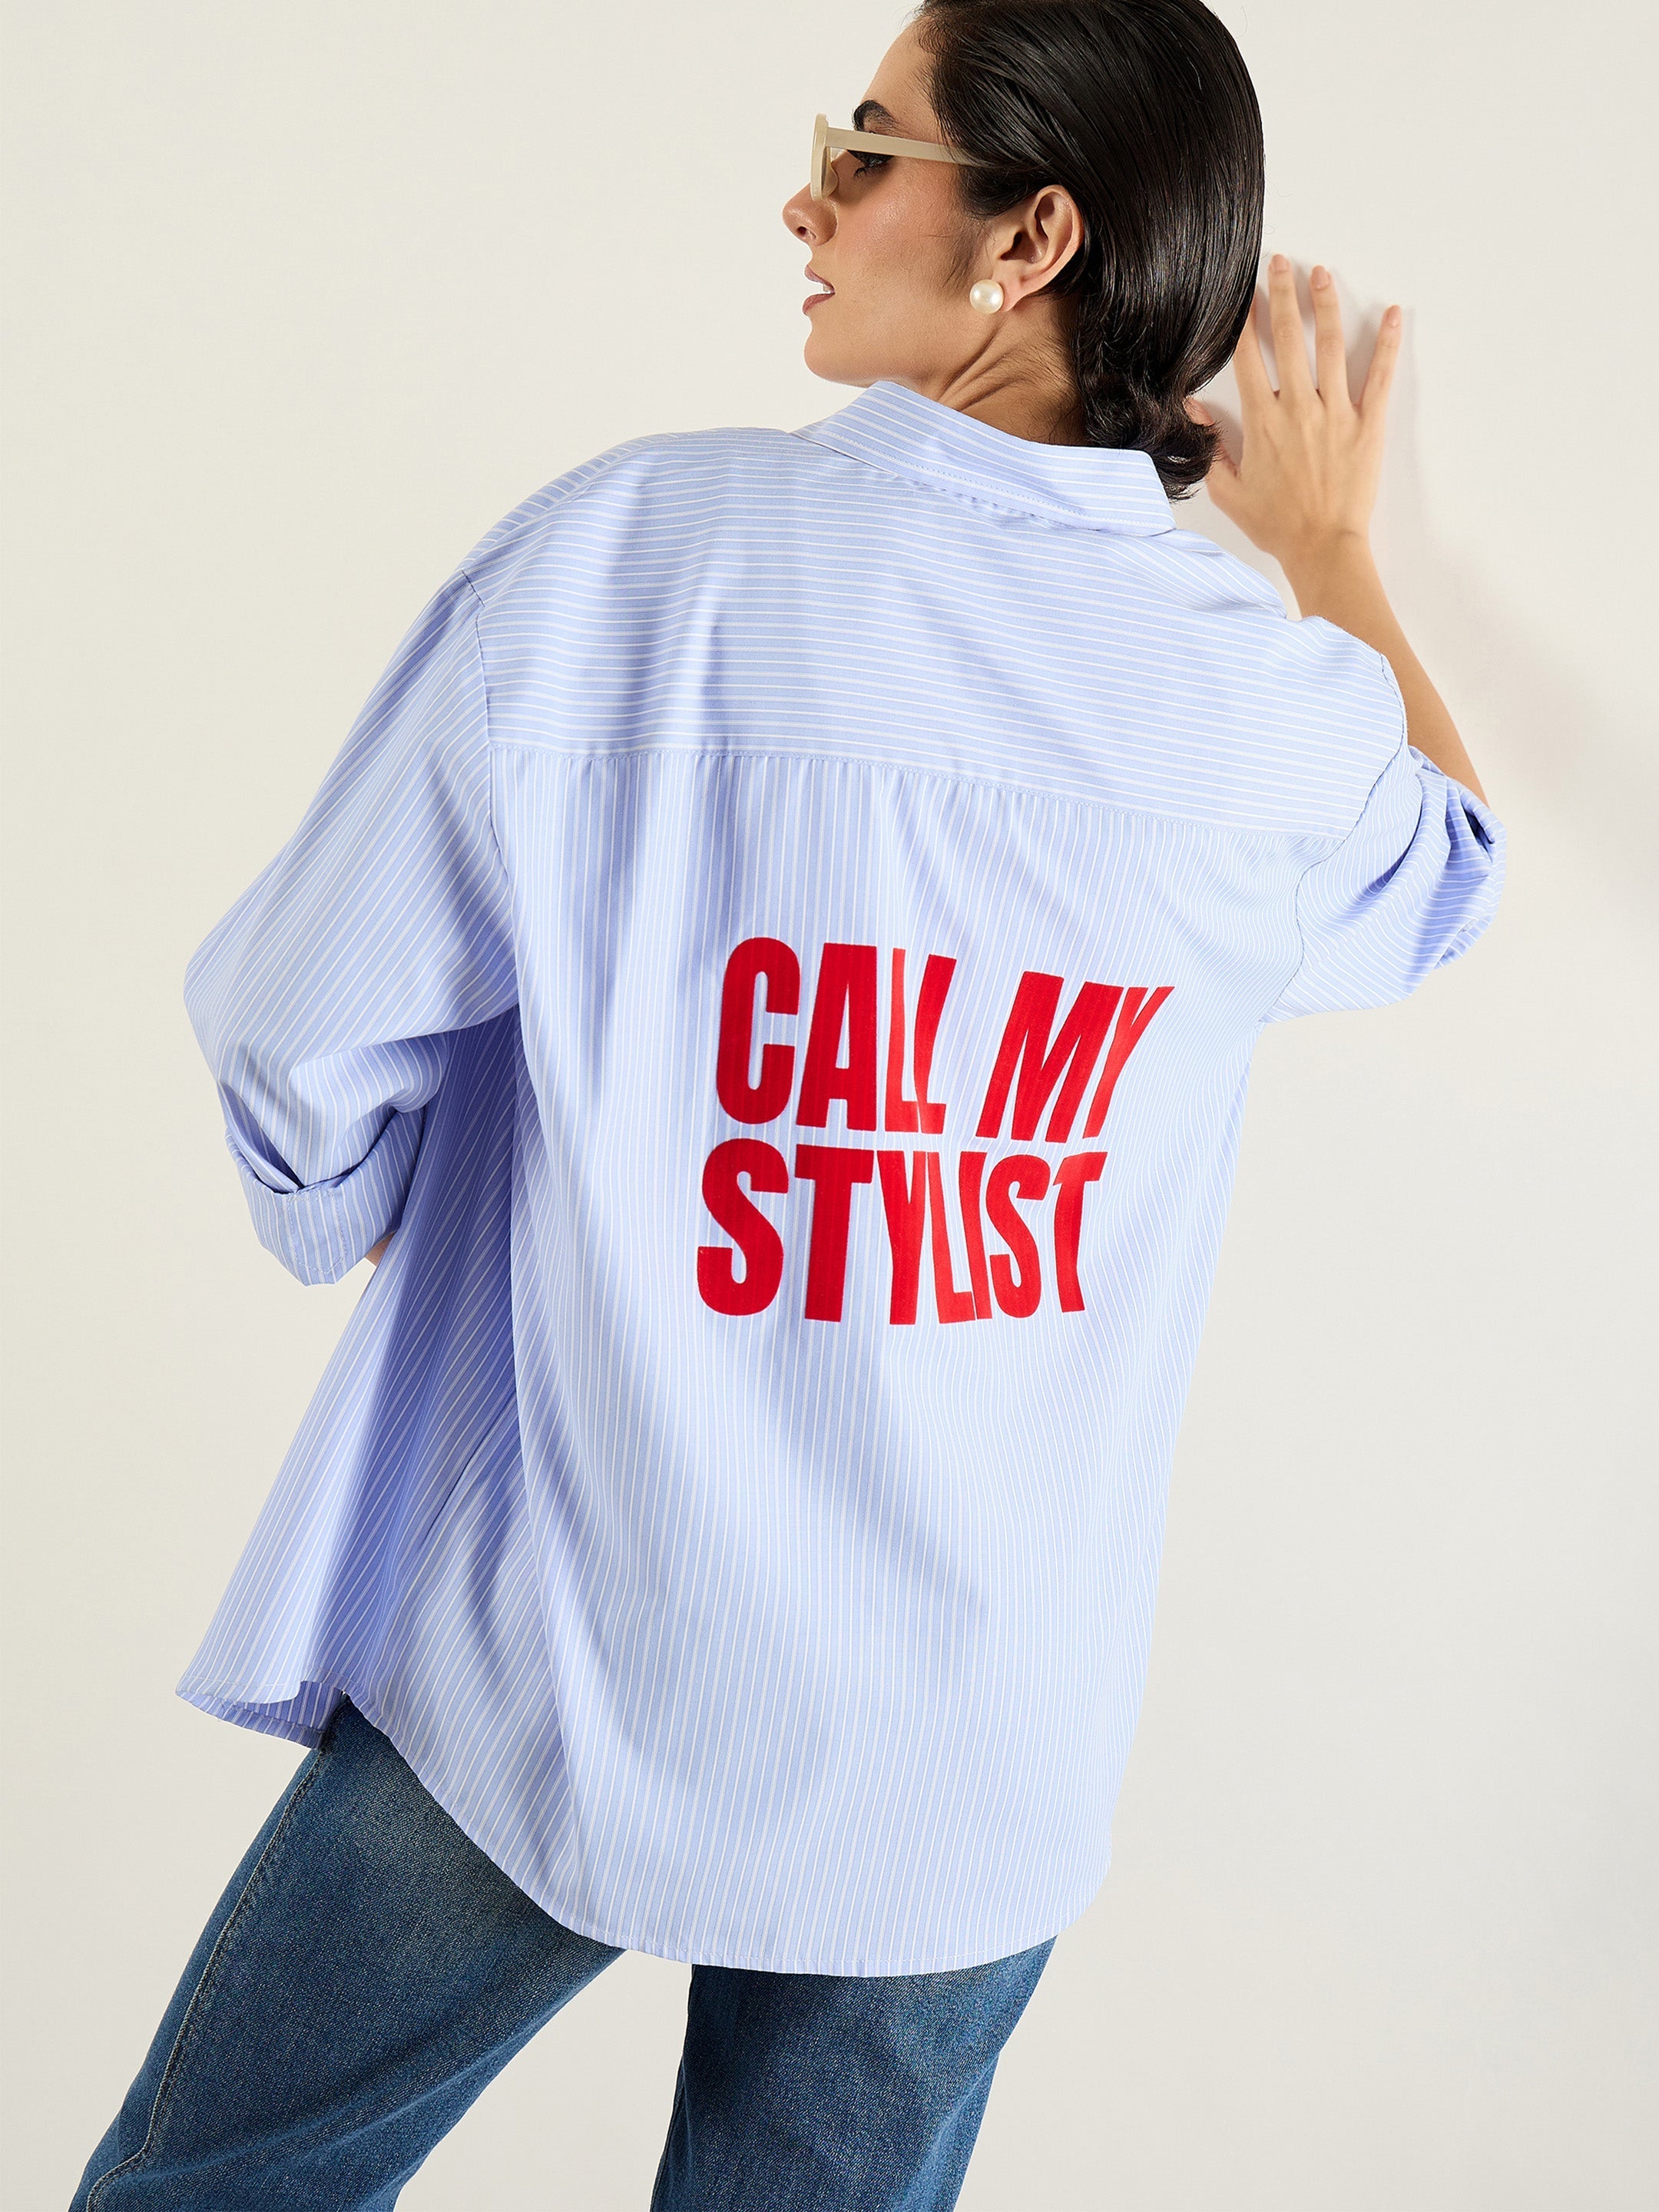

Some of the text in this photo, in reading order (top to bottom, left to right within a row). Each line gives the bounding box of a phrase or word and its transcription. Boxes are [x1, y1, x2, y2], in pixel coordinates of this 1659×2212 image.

[717, 936, 1174, 1144] CALL MY
[697, 1138, 1108, 1325] STYLIST
